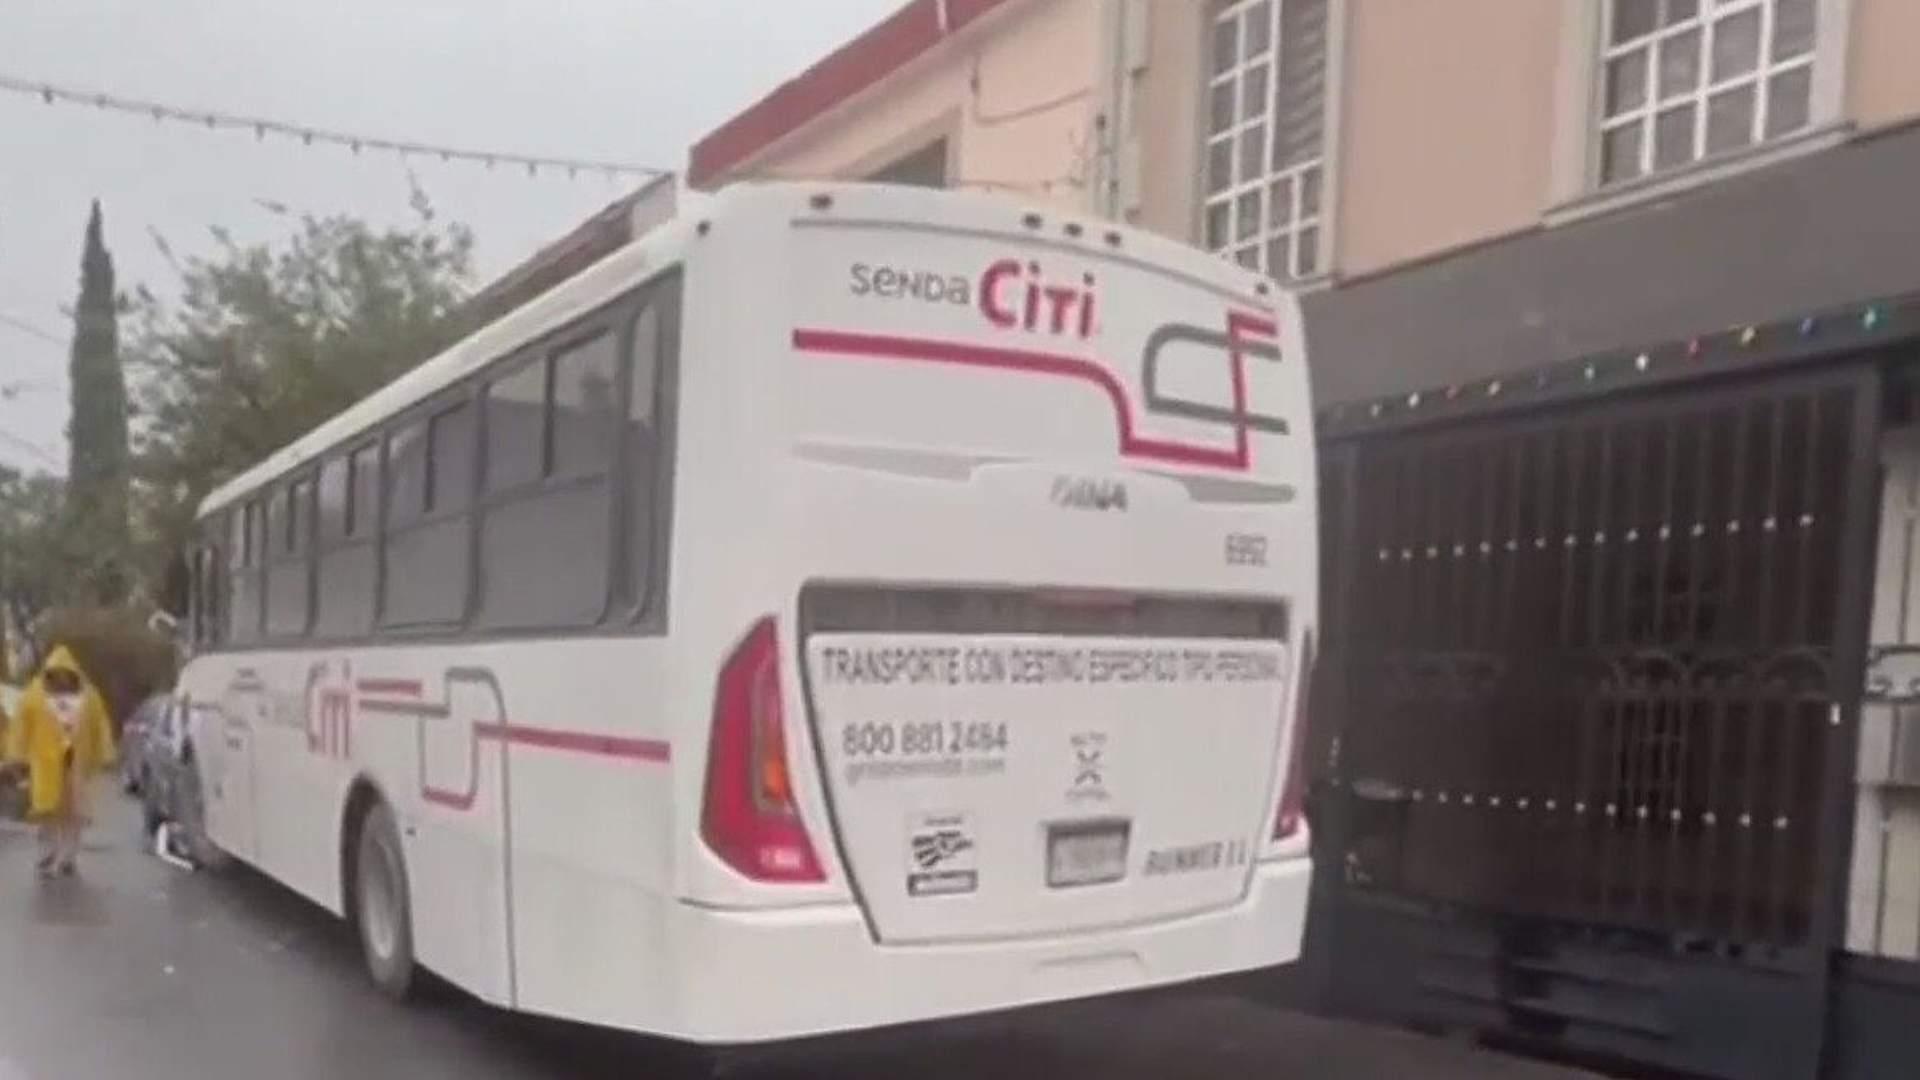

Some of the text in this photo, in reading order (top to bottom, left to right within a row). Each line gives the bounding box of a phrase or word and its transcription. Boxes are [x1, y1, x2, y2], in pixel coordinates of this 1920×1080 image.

[822, 646, 960, 685] TRANSPORTE
[964, 648, 1005, 682] CON
[1010, 648, 1083, 683] DESTINO
[842, 721, 895, 756] 800
